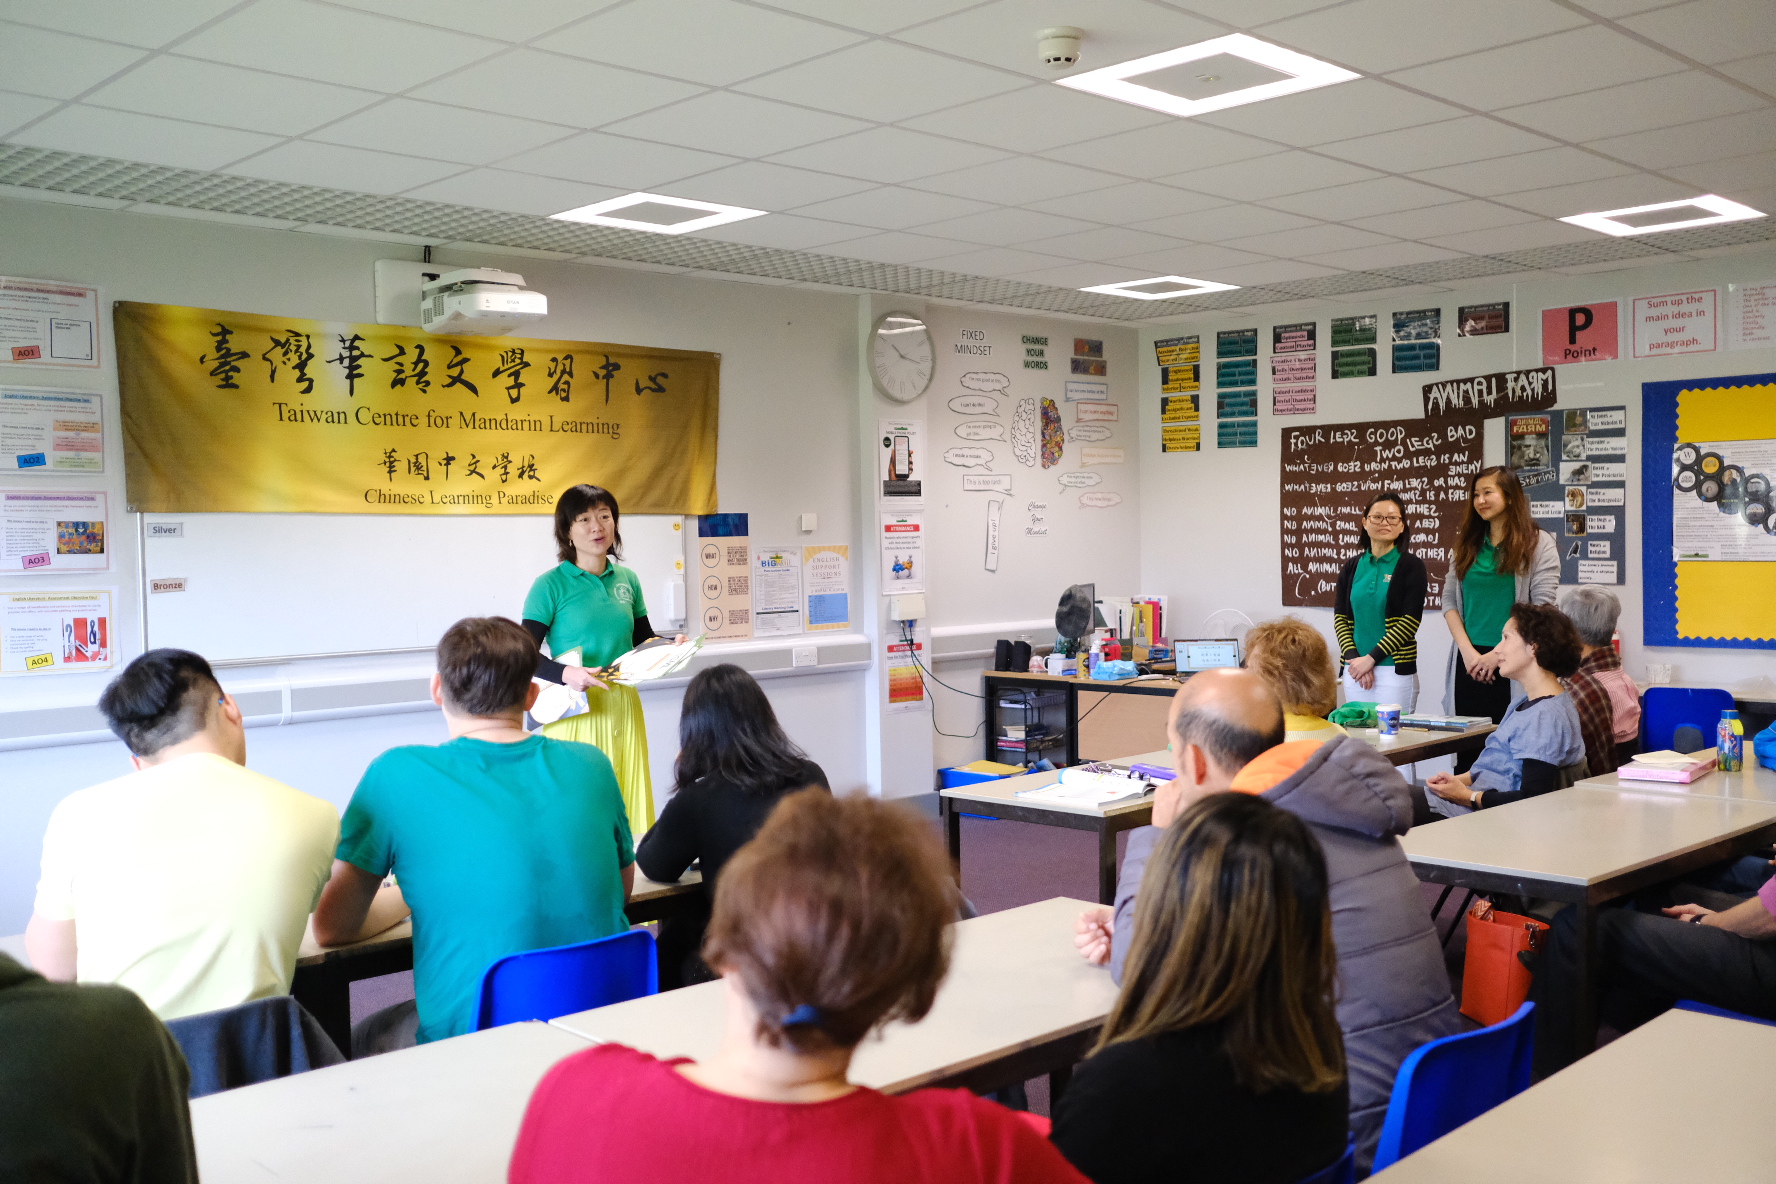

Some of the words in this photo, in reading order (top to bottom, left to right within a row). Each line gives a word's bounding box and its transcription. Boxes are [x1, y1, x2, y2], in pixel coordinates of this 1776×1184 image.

[1647, 299, 1668, 309] Sum
[1671, 298, 1683, 308] up
[1687, 295, 1703, 305] the
[1645, 311, 1669, 323] main
[1671, 309, 1693, 321] idea
[1696, 308, 1705, 318] in
[1568, 306, 1594, 345] P
[1663, 324, 1686, 337] your
[961, 329, 985, 341] FIXED
[1021, 335, 1049, 346] CHANGE
[1281, 333, 1306, 341] Optimistic
[954, 343, 992, 356] MINDSET
[1649, 337, 1702, 352] paragraph.
[17, 349, 35, 358] AO1
[1026, 348, 1044, 357] YOUR
[1564, 346, 1597, 360] Point
[199, 322, 669, 406] 臺灣華語文學習中心
[1023, 359, 1049, 370] WORDS
[1289, 365, 1314, 373] Overjoyed
[1291, 387, 1315, 395] Confident
[1428, 377, 1497, 416] ANIMAL
[1505, 369, 1553, 402] FARM
[1293, 405, 1315, 413] Inspired
[272, 401, 349, 425] Taiwan
[355, 406, 419, 428] Centre
[426, 409, 452, 429] for
[459, 410, 543, 433] Mandarin
[549, 414, 621, 440] Learning
[1517, 418, 1543, 426] ANIMAL
[1513, 424, 1546, 434] FARM
[1290, 429, 1325, 452] FOUR
[1366, 426, 1405, 444] GOOD
[1406, 432, 1442, 452] LEGS
[1447, 425, 1476, 442] BAD
[1374, 445, 1404, 462] TWO
[1683, 451, 1693, 459] W
[23, 456, 40, 465] AO2
[377, 447, 542, 484] 華園中文學校
[1285, 461, 1334, 474] WHATEVER
[1338, 460, 1361, 473] GOES
[1364, 460, 1389, 473] UPON
[1390, 458, 1411, 470] TWO
[1413, 454, 1438, 469] LEGS
[1440, 453, 1450, 464] IS
[1452, 450, 1469, 463] AN
[1448, 459, 1482, 476] ENEMY
[966, 478, 977, 486] This
[982, 478, 991, 486] too
[1284, 481, 1331, 493] WHATEVER
[1336, 481, 1359, 492] GOES
[1361, 479, 1382, 492] UPON
[1384, 479, 1404, 491] FOUR
[1405, 476, 1430, 491] LEGS
[1433, 476, 1446, 488] OR
[1447, 476, 1467, 488] HAS
[1519, 471, 1557, 488] Starring
[364, 488, 425, 505] Chinese
[429, 489, 493, 509] Learning
[497, 490, 554, 506] Paradise
[1426, 490, 1435, 500] IS
[1439, 490, 1446, 500] A
[1027, 500, 1047, 512] Change
[1283, 506, 1297, 517] NO
[1302, 505, 1336, 517] ANIMAL
[1337, 505, 1363, 515] SHALL
[1030, 513, 1044, 525] Your
[152, 526, 177, 535] Silver
[990, 518, 998, 533] up!
[1025, 526, 1048, 536] Mindset
[1283, 520, 1297, 530] NO
[1301, 519, 1333, 532] ANIMAL
[1335, 521, 1359, 532] SHALL
[1283, 534, 1297, 544] NO
[1302, 532, 1336, 545] ANIMAL
[705, 552, 717, 560] WHAT
[812, 556, 840, 564] ENGLISH
[1284, 546, 1300, 558] NO
[1303, 546, 1338, 559] ANIMAL
[1415, 547, 1445, 562] OTHER
[28, 556, 45, 566] AO3
[811, 563, 841, 571] SUPPORT
[811, 570, 842, 578] SESSIONS
[1287, 561, 1304, 575] ALL
[1307, 561, 1341, 575] ANIMAL
[153, 582, 183, 591] Bronze
[707, 584, 718, 592] HOW
[1317, 578, 1337, 594] (BUT
[708, 615, 718, 623] WHY
[31, 656, 49, 667] AO4
